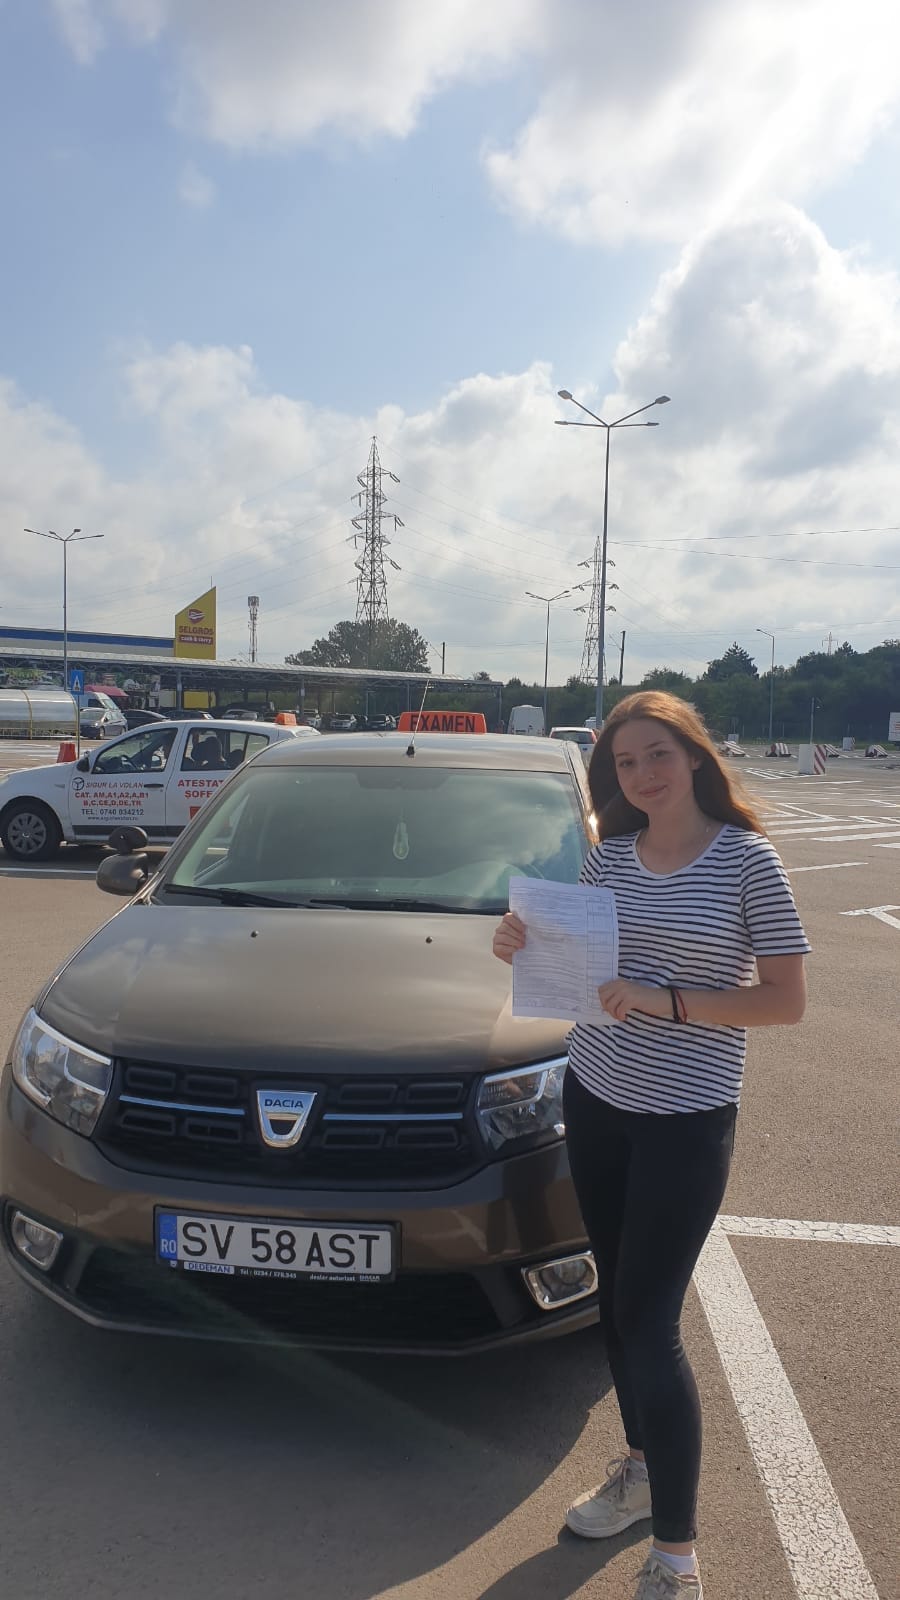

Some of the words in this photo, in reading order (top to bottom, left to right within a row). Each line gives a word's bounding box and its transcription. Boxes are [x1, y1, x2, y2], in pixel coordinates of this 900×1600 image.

[178, 625, 214, 636] SELGROS
[410, 714, 475, 733] EXAMEN
[74, 791, 91, 799] CAT.
[99, 808, 117, 816] 0740
[265, 1098, 304, 1108] DACIA
[161, 1238, 176, 1254] RO
[182, 1221, 235, 1260] SV
[251, 1227, 297, 1264] 58
[305, 1231, 380, 1269] AST
[188, 1262, 231, 1273] DEDEMAN
